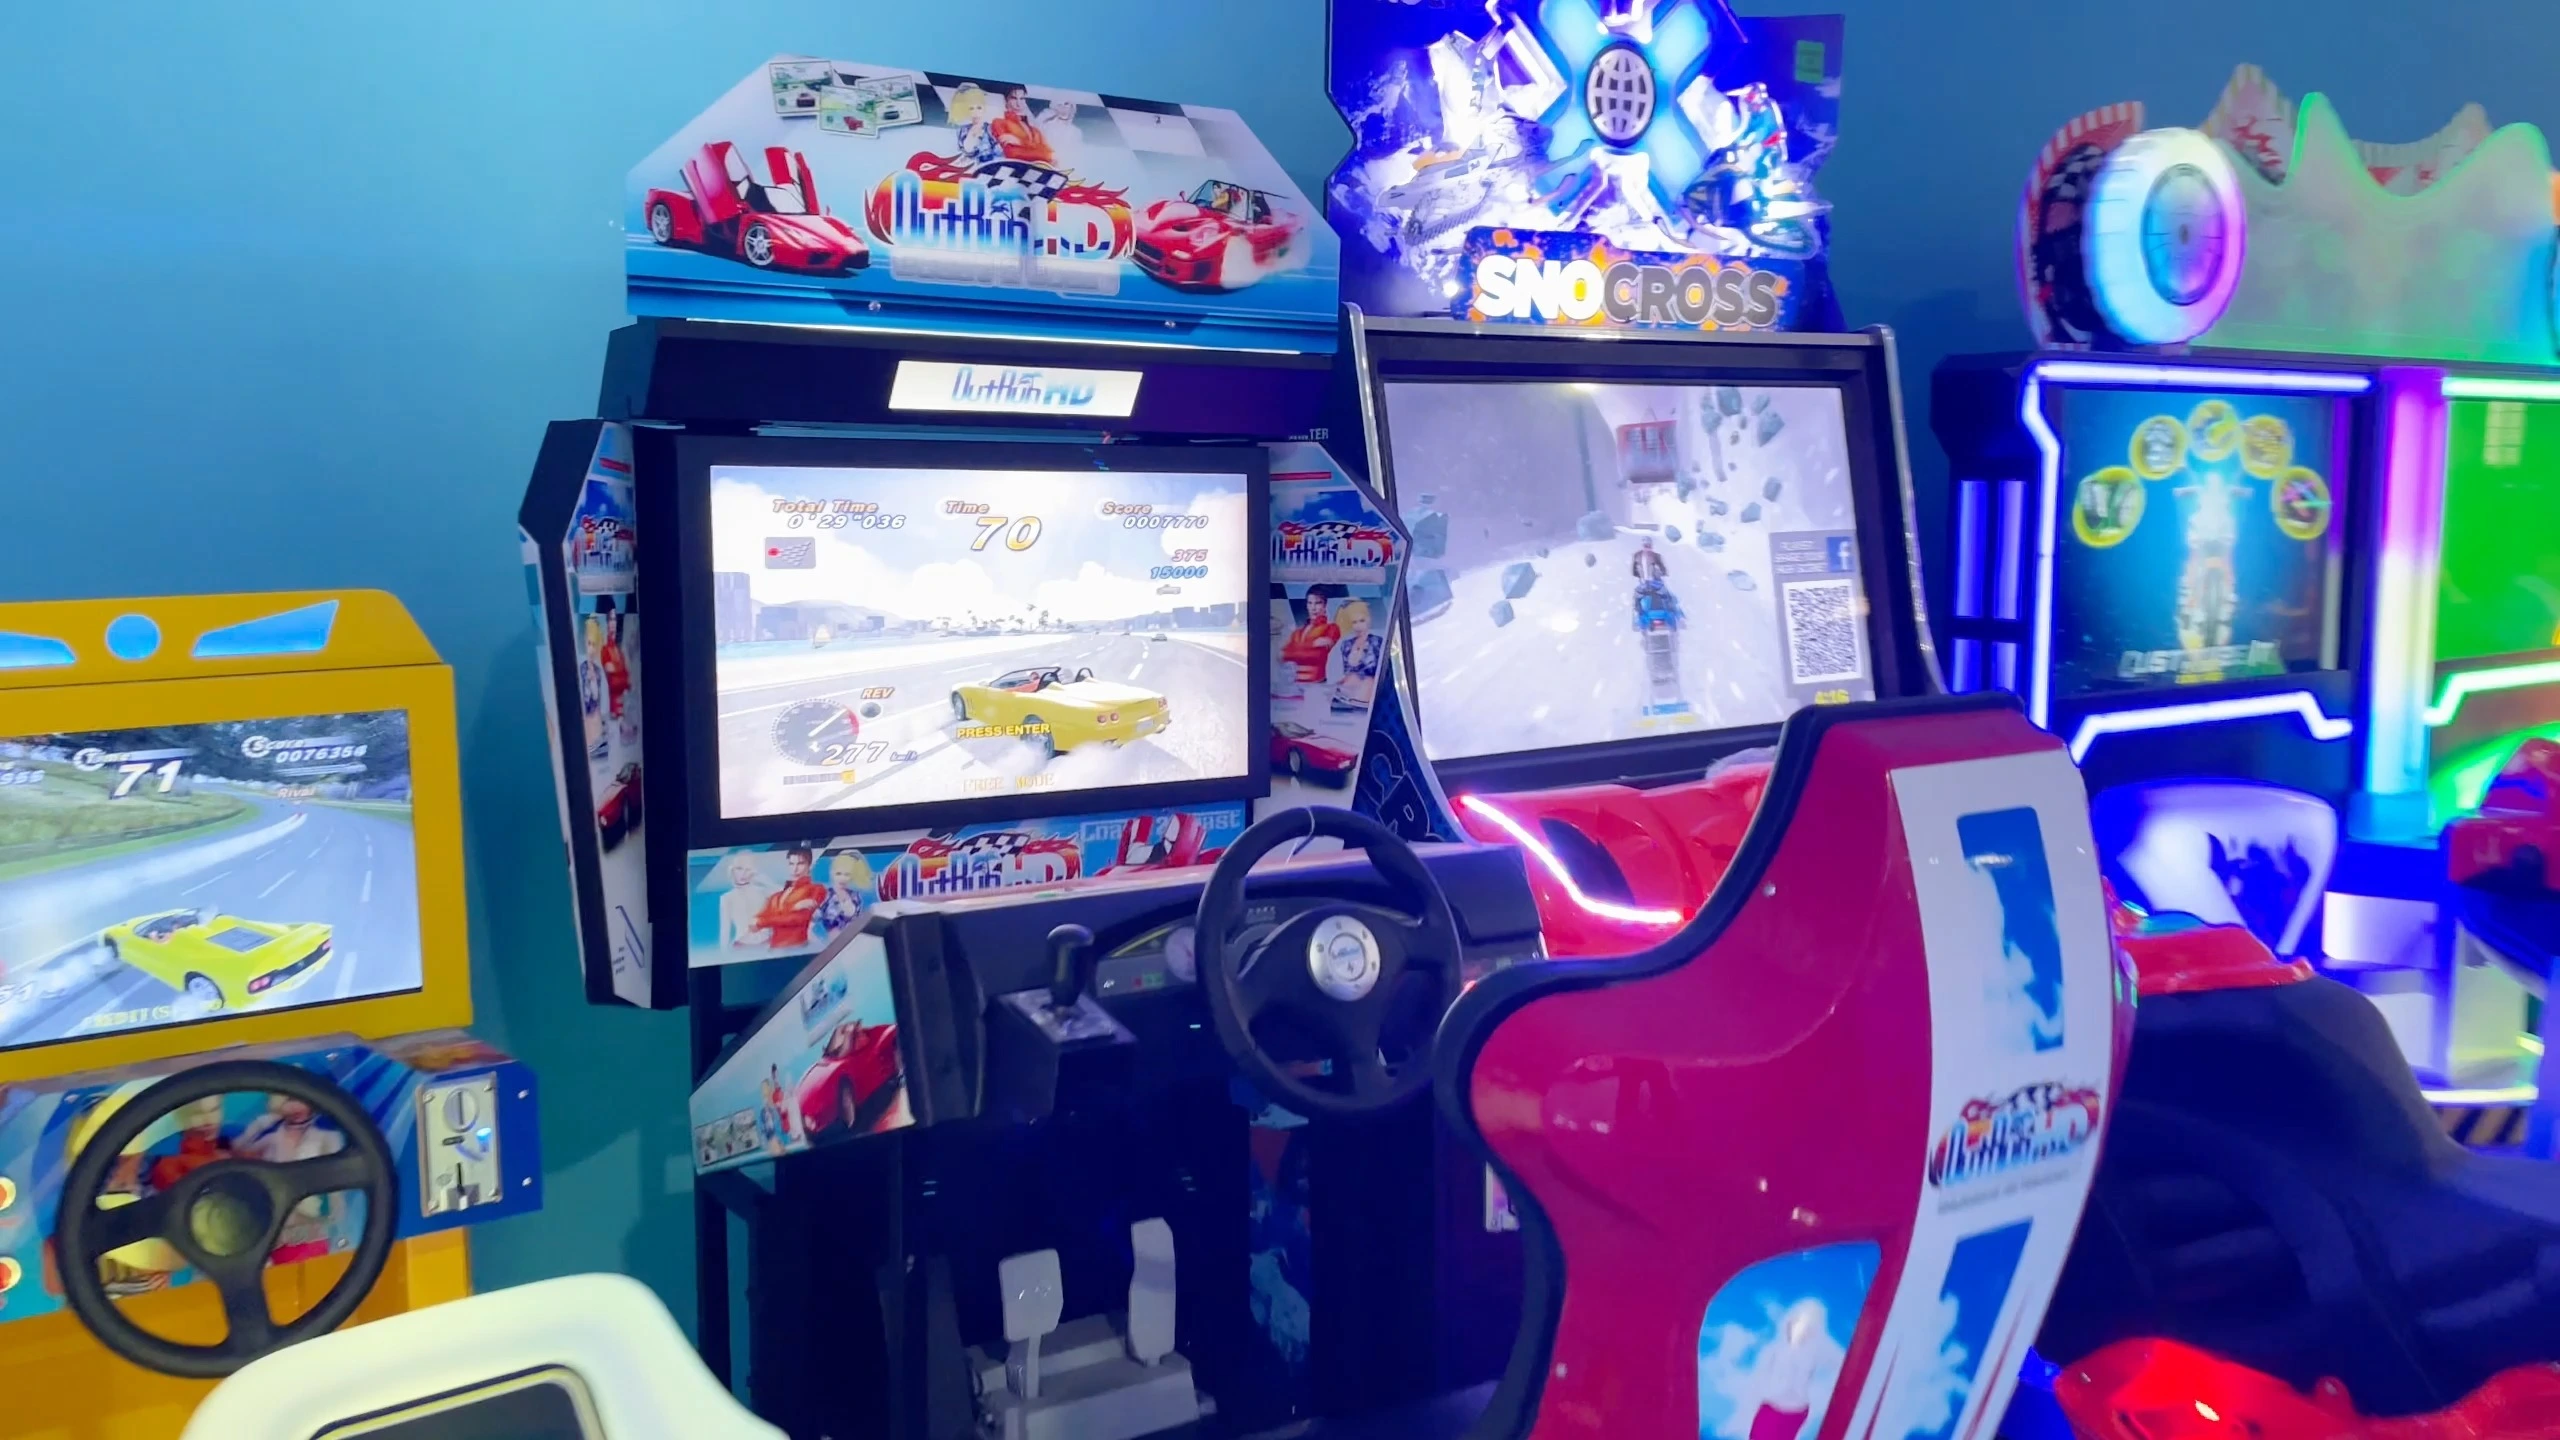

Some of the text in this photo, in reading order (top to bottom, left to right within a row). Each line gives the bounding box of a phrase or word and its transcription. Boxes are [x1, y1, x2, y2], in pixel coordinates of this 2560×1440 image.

[772, 498, 880, 514] Total Time
[946, 500, 991, 515] Time
[1101, 501, 1152, 516] Score
[1122, 515, 1209, 530] 0007770
[970, 515, 1042, 552] 70
[1171, 548, 1208, 563] 375
[1150, 565, 1208, 580] 15000
[861, 687, 895, 700] REV
[957, 723, 1051, 739] PRESS ENTER
[821, 741, 890, 767] 277
[110, 759, 183, 799] 71
